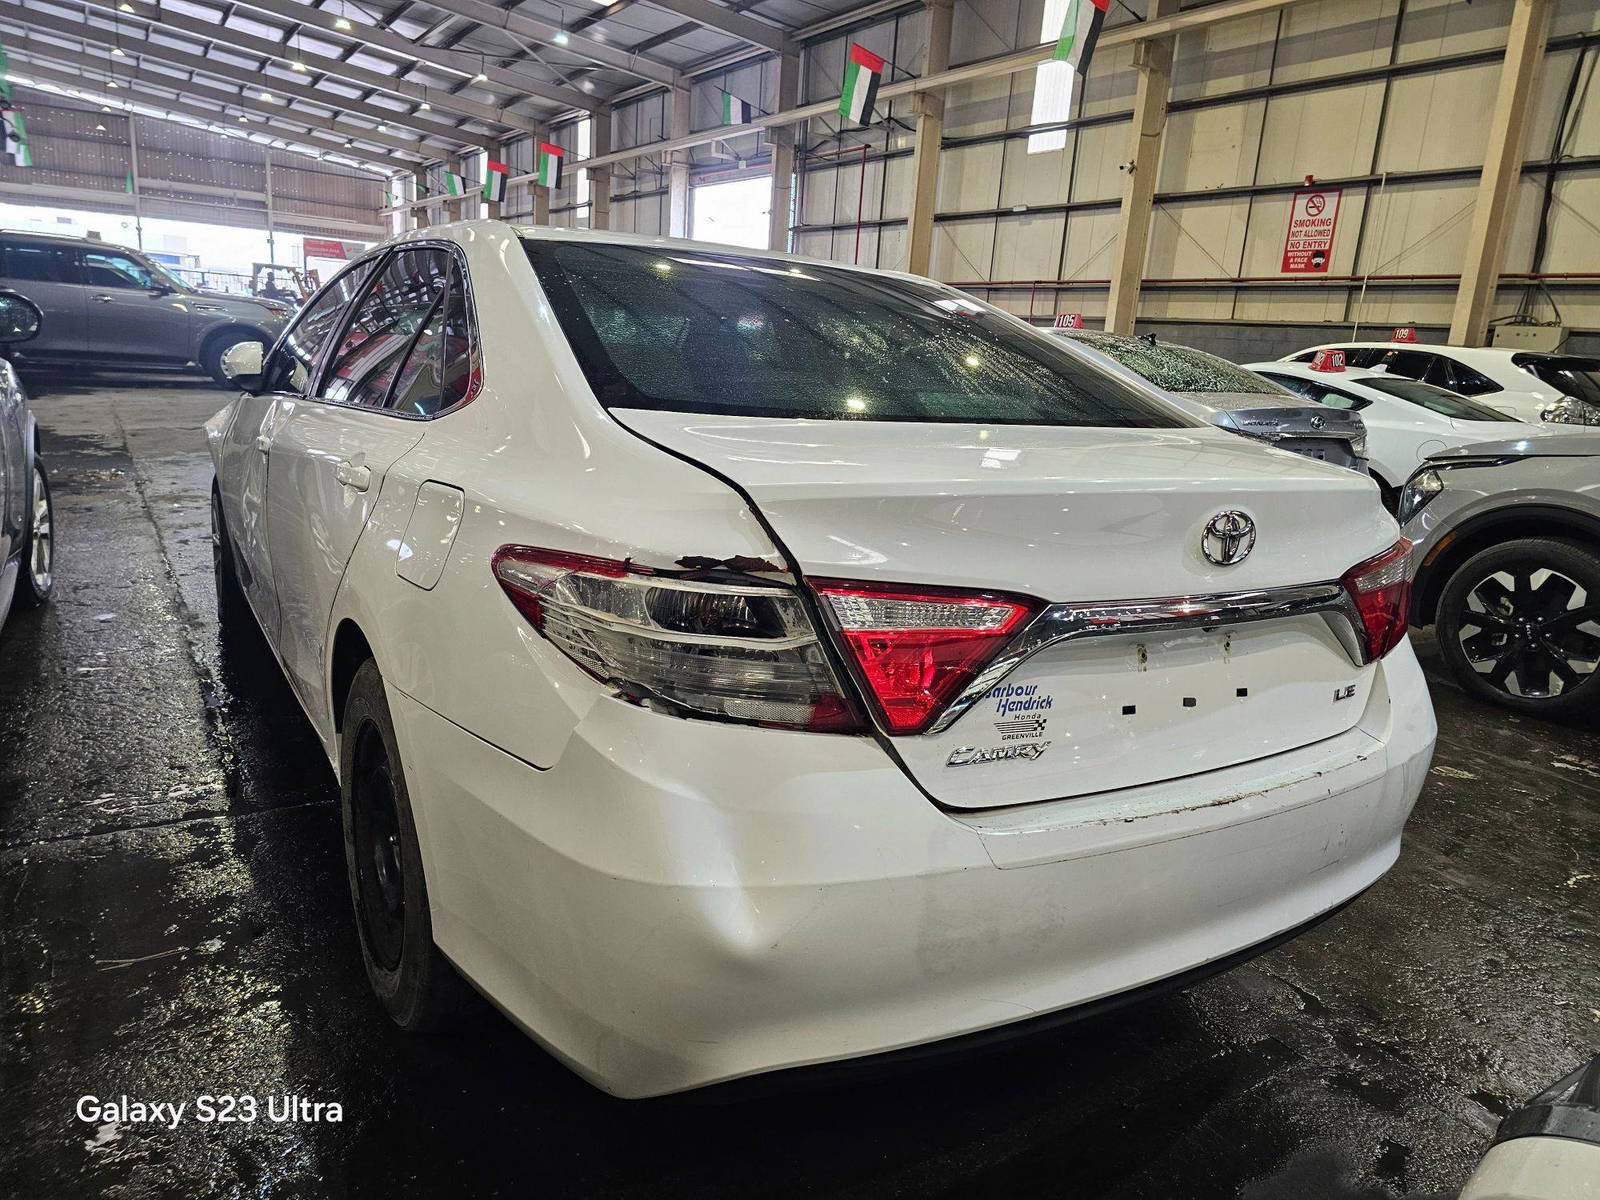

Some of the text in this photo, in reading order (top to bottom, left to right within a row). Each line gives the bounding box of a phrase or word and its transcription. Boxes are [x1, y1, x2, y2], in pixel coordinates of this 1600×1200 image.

[1293, 218, 1332, 228] SMOKING
[1291, 229, 1331, 238] NOT ALLOWED
[1289, 240, 1328, 249] NO ENTRY
[1059, 315, 1075, 327] 105
[1395, 328, 1409, 339] 109
[1331, 352, 1343, 367] 102
[1332, 684, 1356, 703] LE
[996, 695, 1054, 717] Hendrick
[1013, 713, 1042, 721] Honda
[1002, 731, 1043, 740] GREENVILLE
